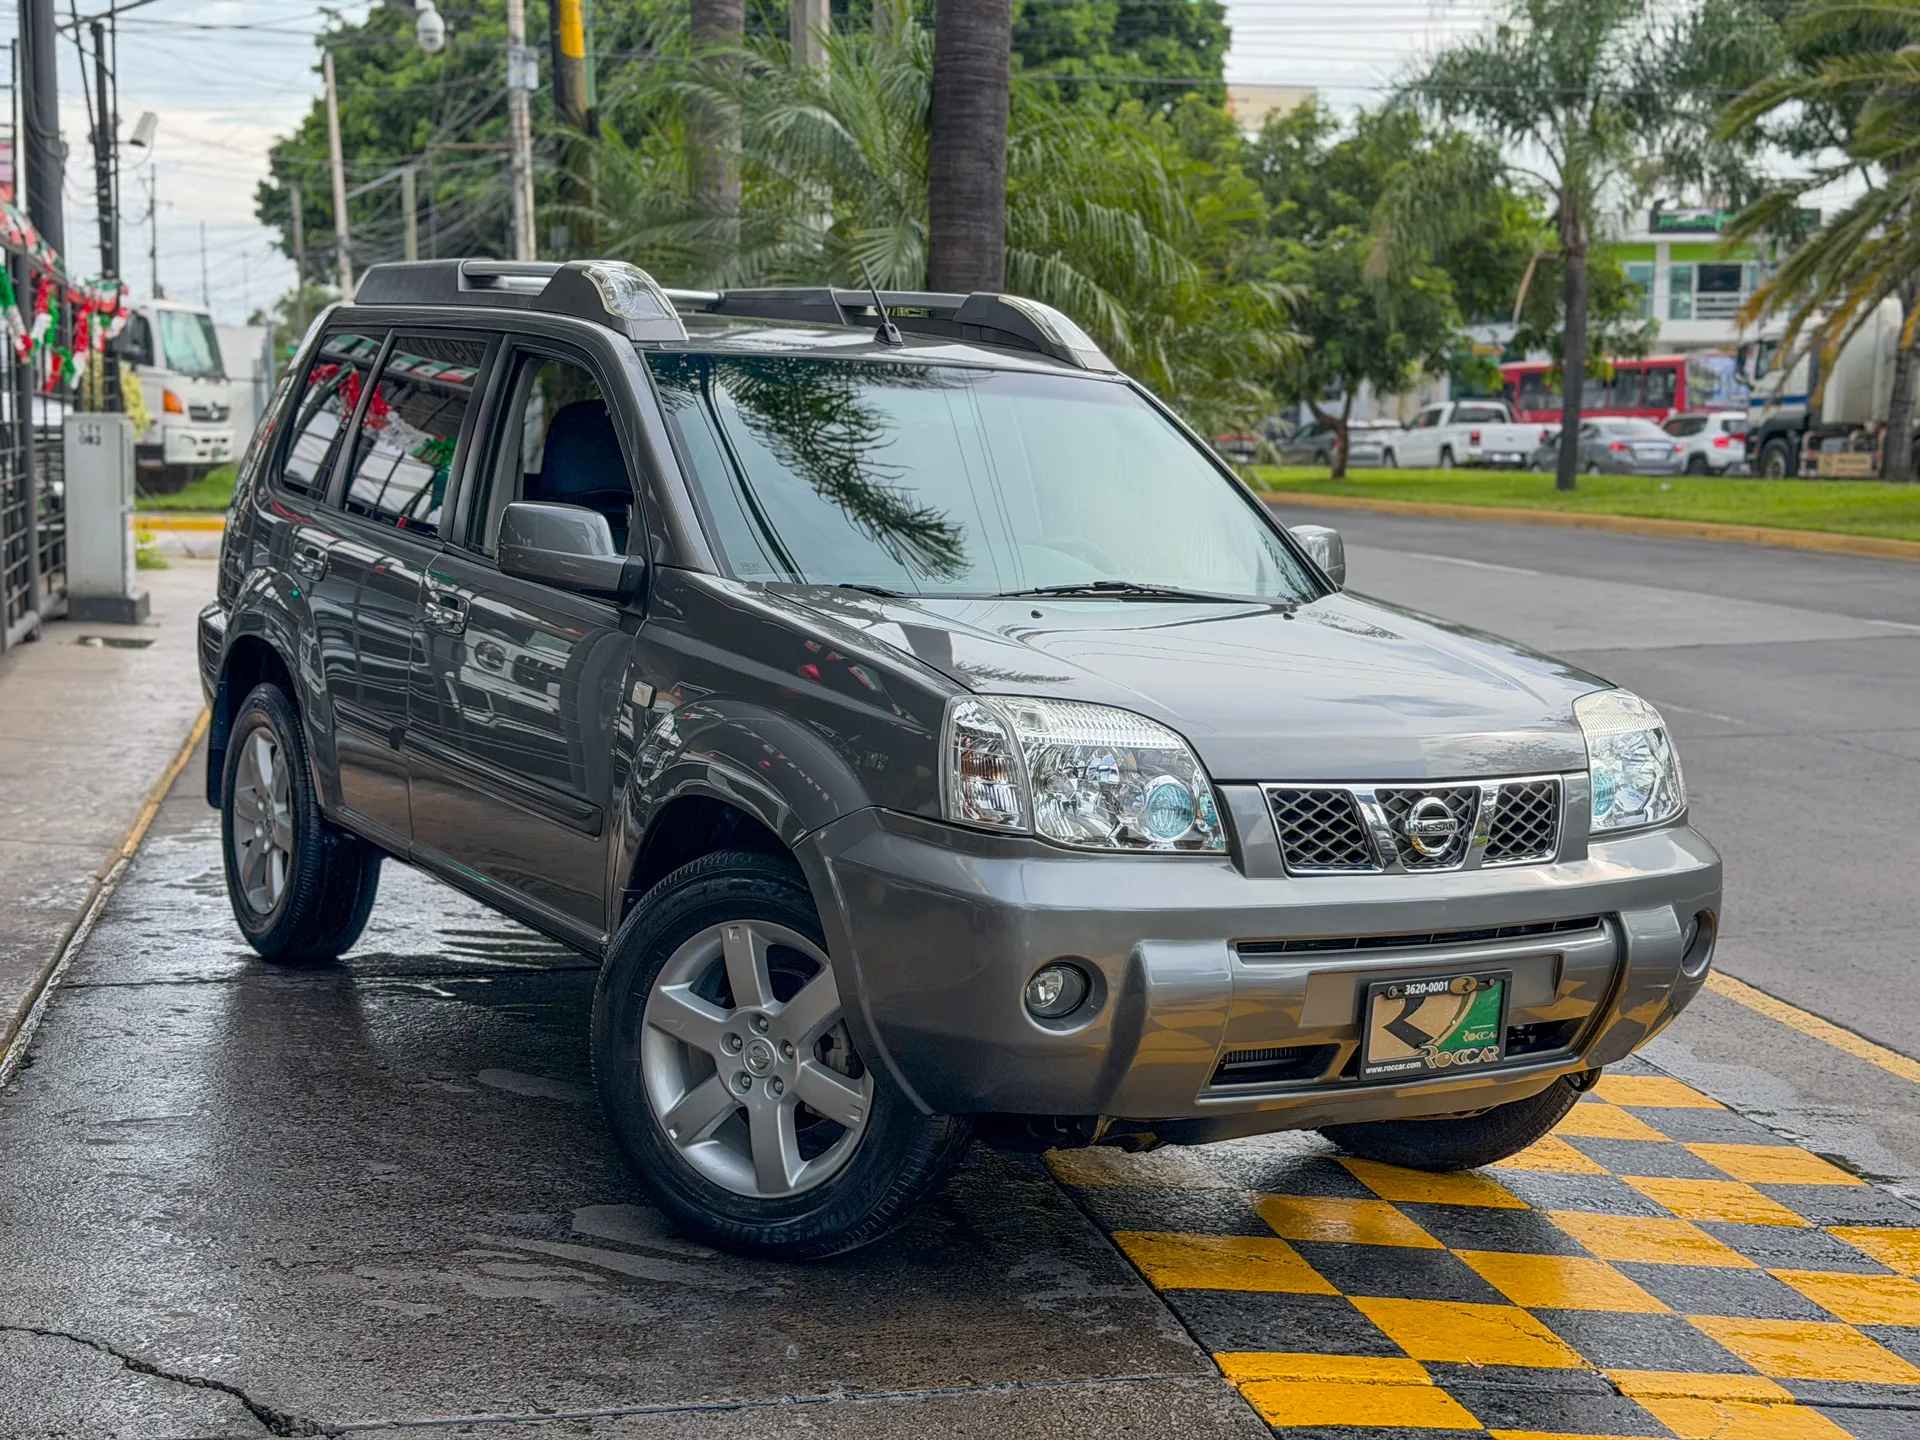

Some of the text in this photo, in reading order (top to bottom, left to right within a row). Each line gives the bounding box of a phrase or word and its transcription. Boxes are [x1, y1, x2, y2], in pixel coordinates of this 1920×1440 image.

[1415, 822, 1456, 833] NISSAN
[1404, 981, 1449, 995] 3620-0001
[1365, 1061, 1421, 1074] www.roccar.com
